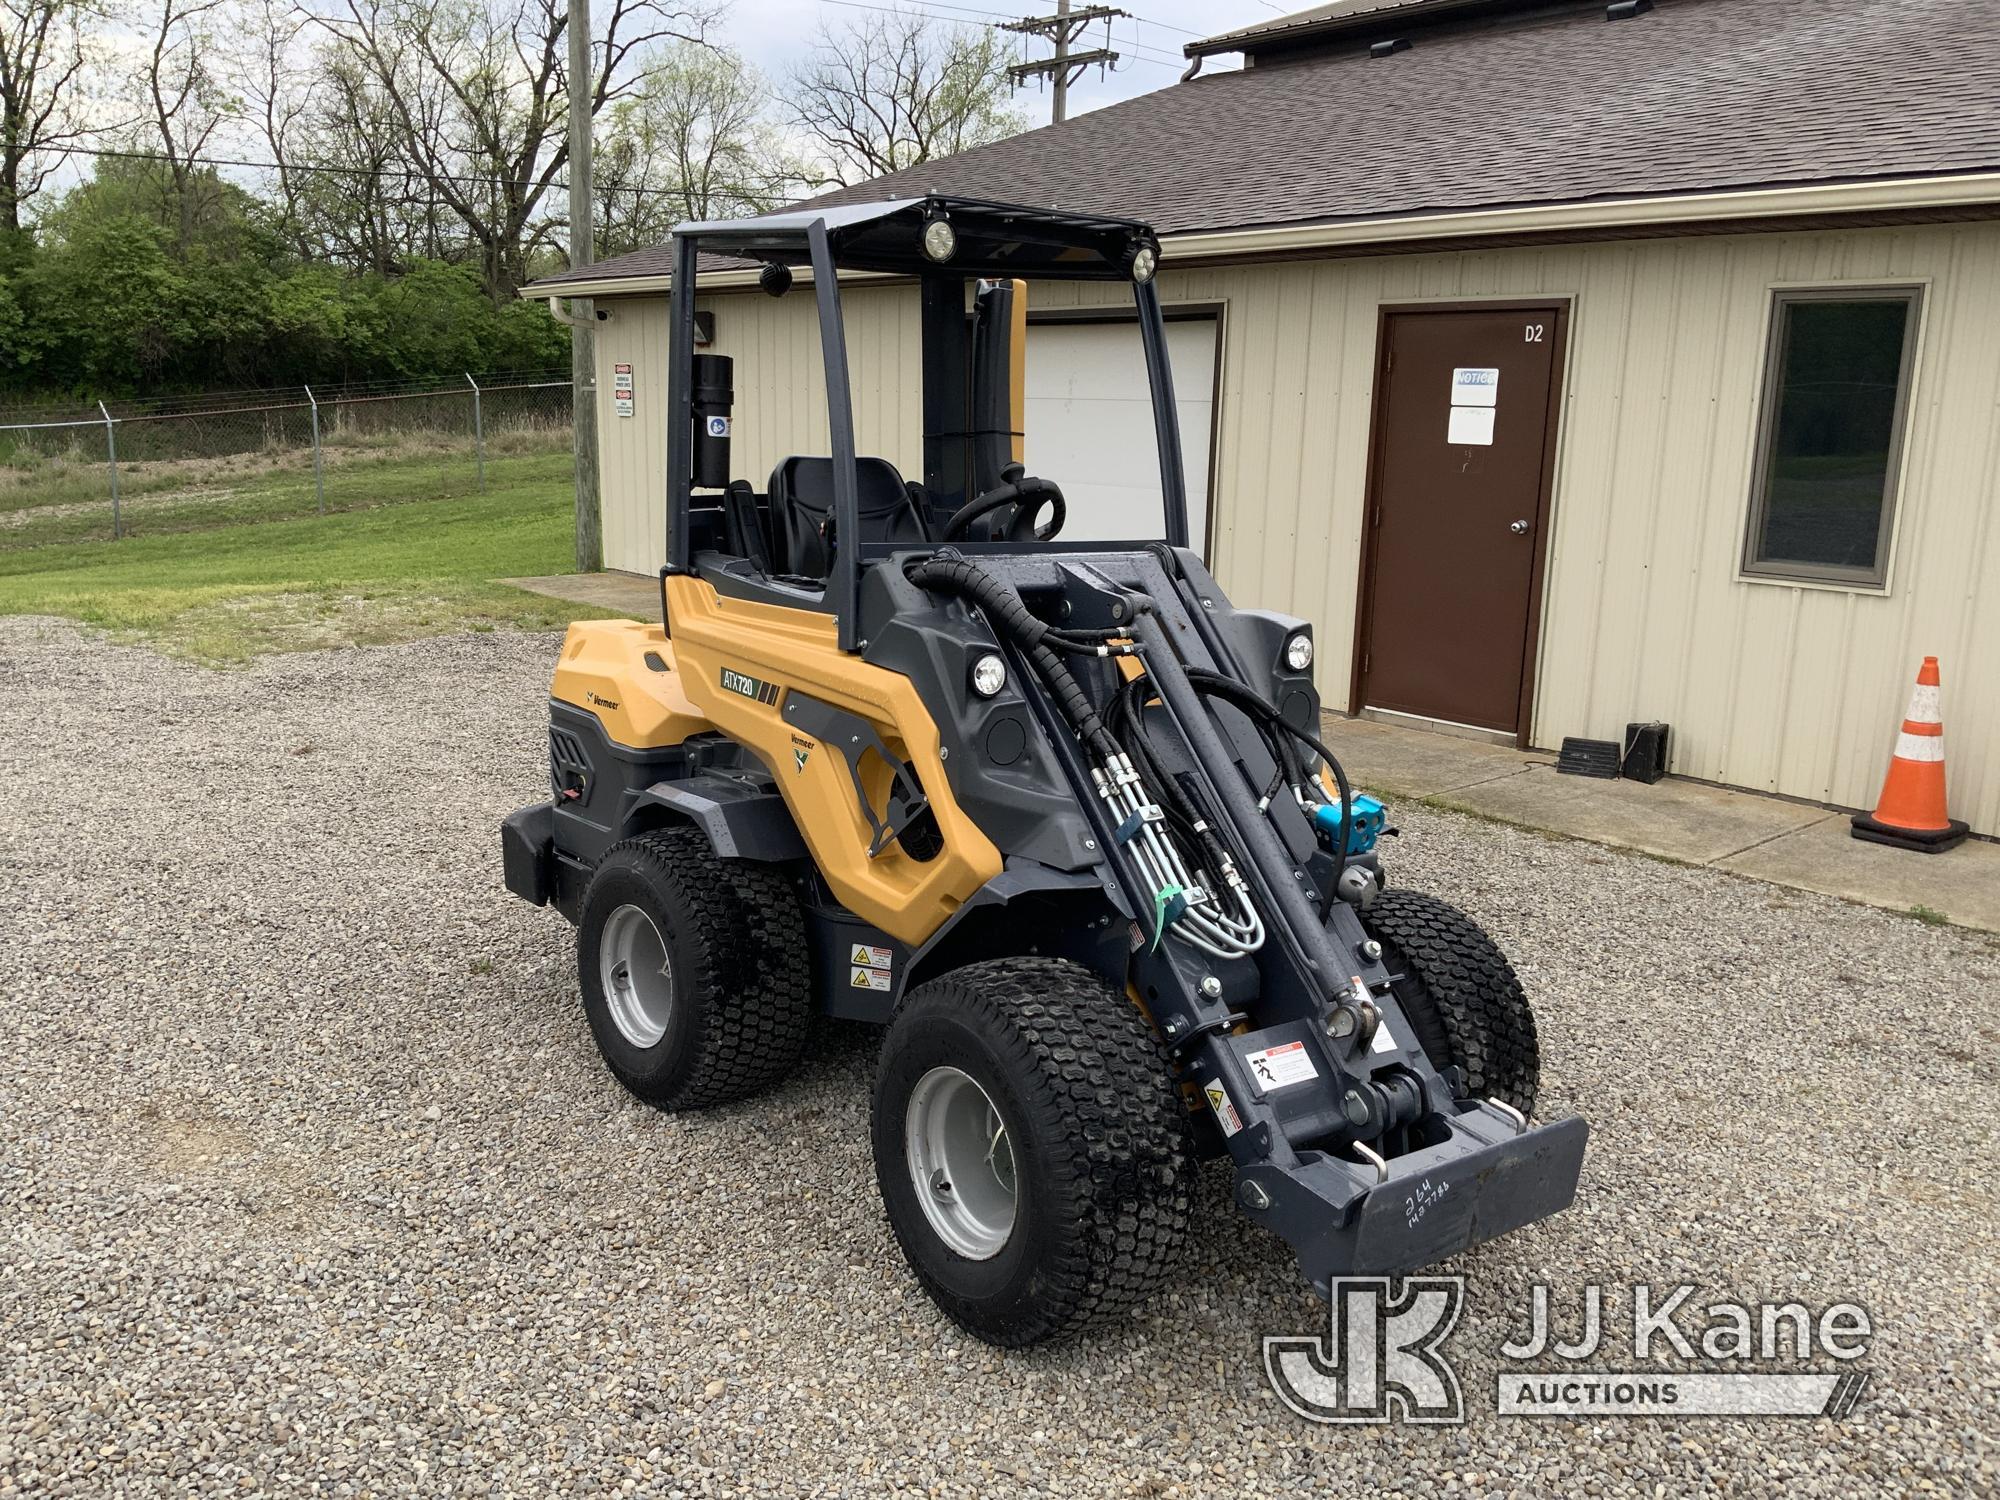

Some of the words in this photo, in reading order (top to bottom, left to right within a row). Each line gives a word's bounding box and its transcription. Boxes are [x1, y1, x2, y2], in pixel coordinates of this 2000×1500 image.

[1524, 324, 1544, 343] D2
[723, 669, 754, 697] ATX720
[593, 694, 618, 711] Vermeer
[791, 732, 815, 750] Vermeer
[1405, 1178, 1432, 1217] 264
